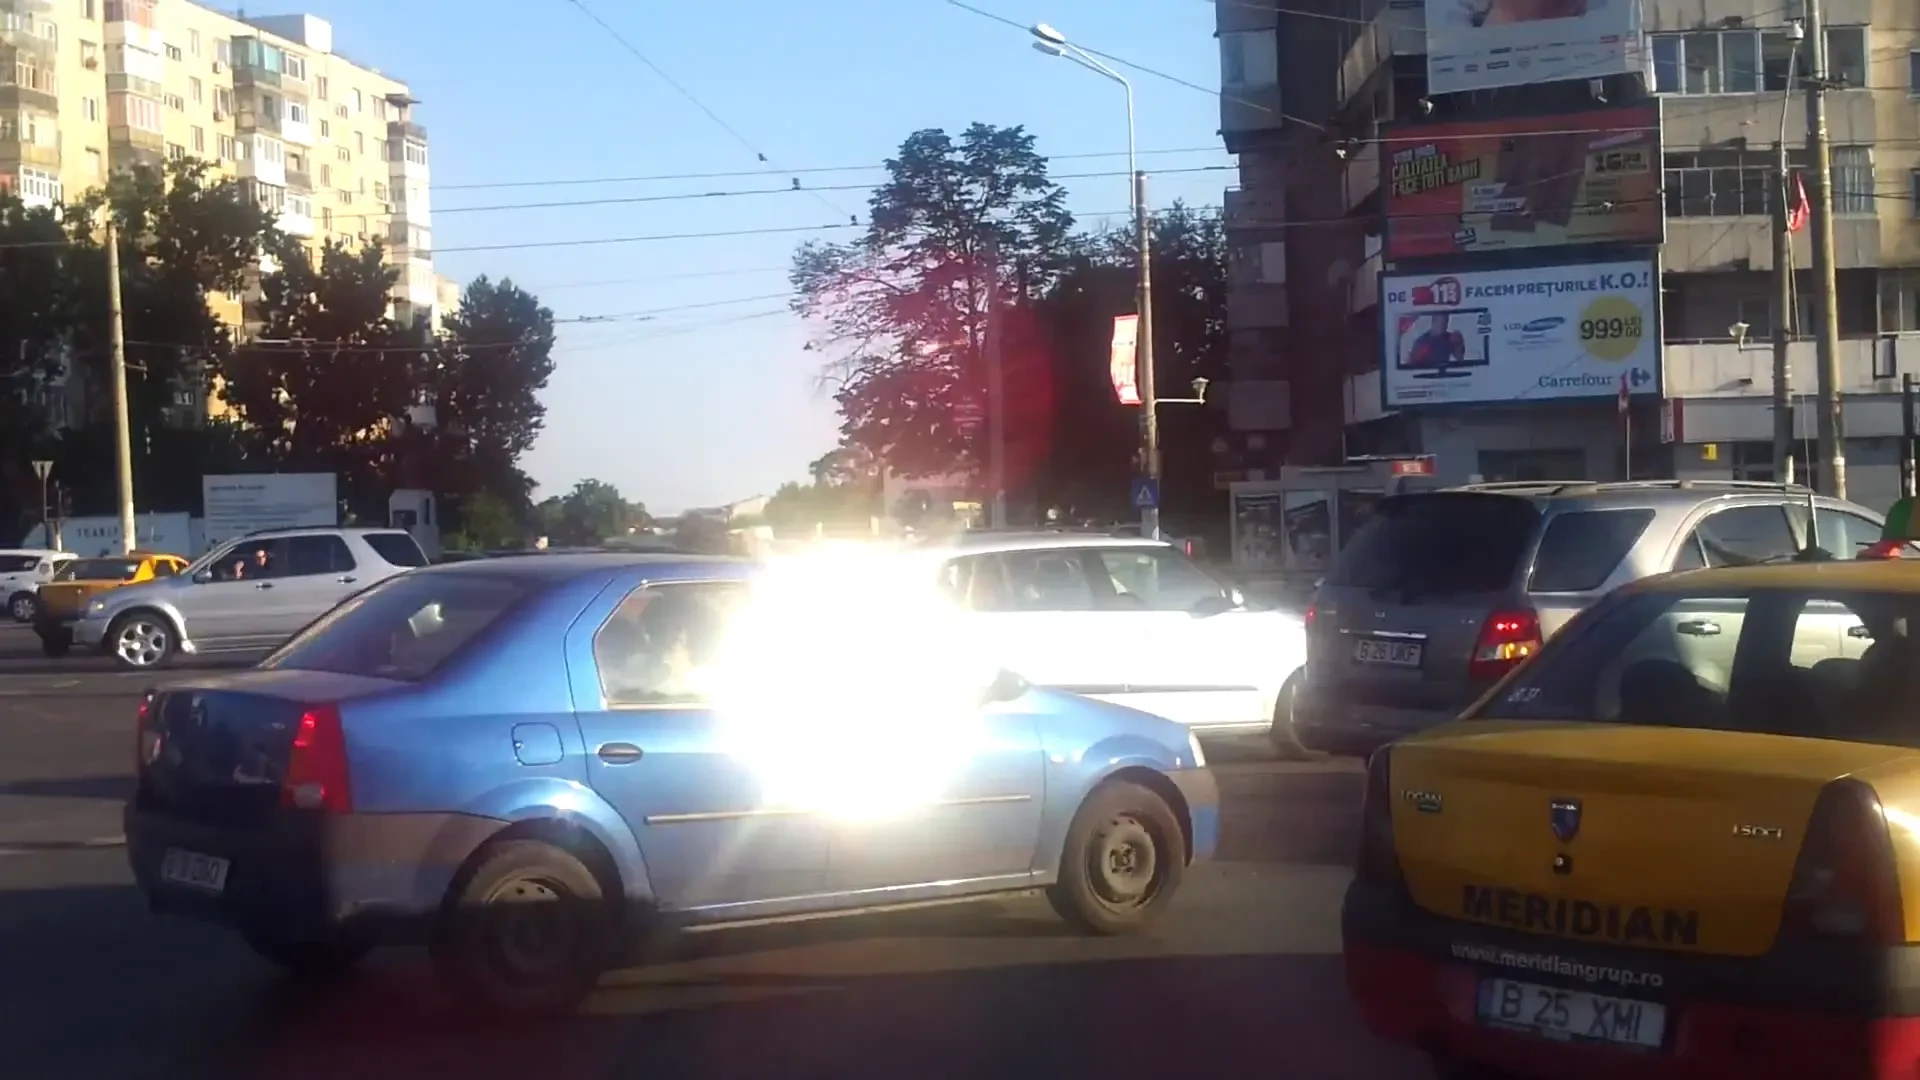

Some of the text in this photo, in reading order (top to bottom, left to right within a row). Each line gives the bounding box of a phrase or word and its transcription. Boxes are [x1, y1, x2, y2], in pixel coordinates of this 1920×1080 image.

[1388, 291, 1407, 303] DE
[1465, 284, 1514, 299] FACEM
[1600, 271, 1649, 291] K.O.!
[1580, 317, 1623, 340] 999
[1538, 373, 1614, 389] Carrefour
[1462, 884, 1698, 945] MERIDIAN
[1451, 943, 1664, 987] www.meridiangrup.ro
[1500, 983, 1643, 1042] B 25 XMI
